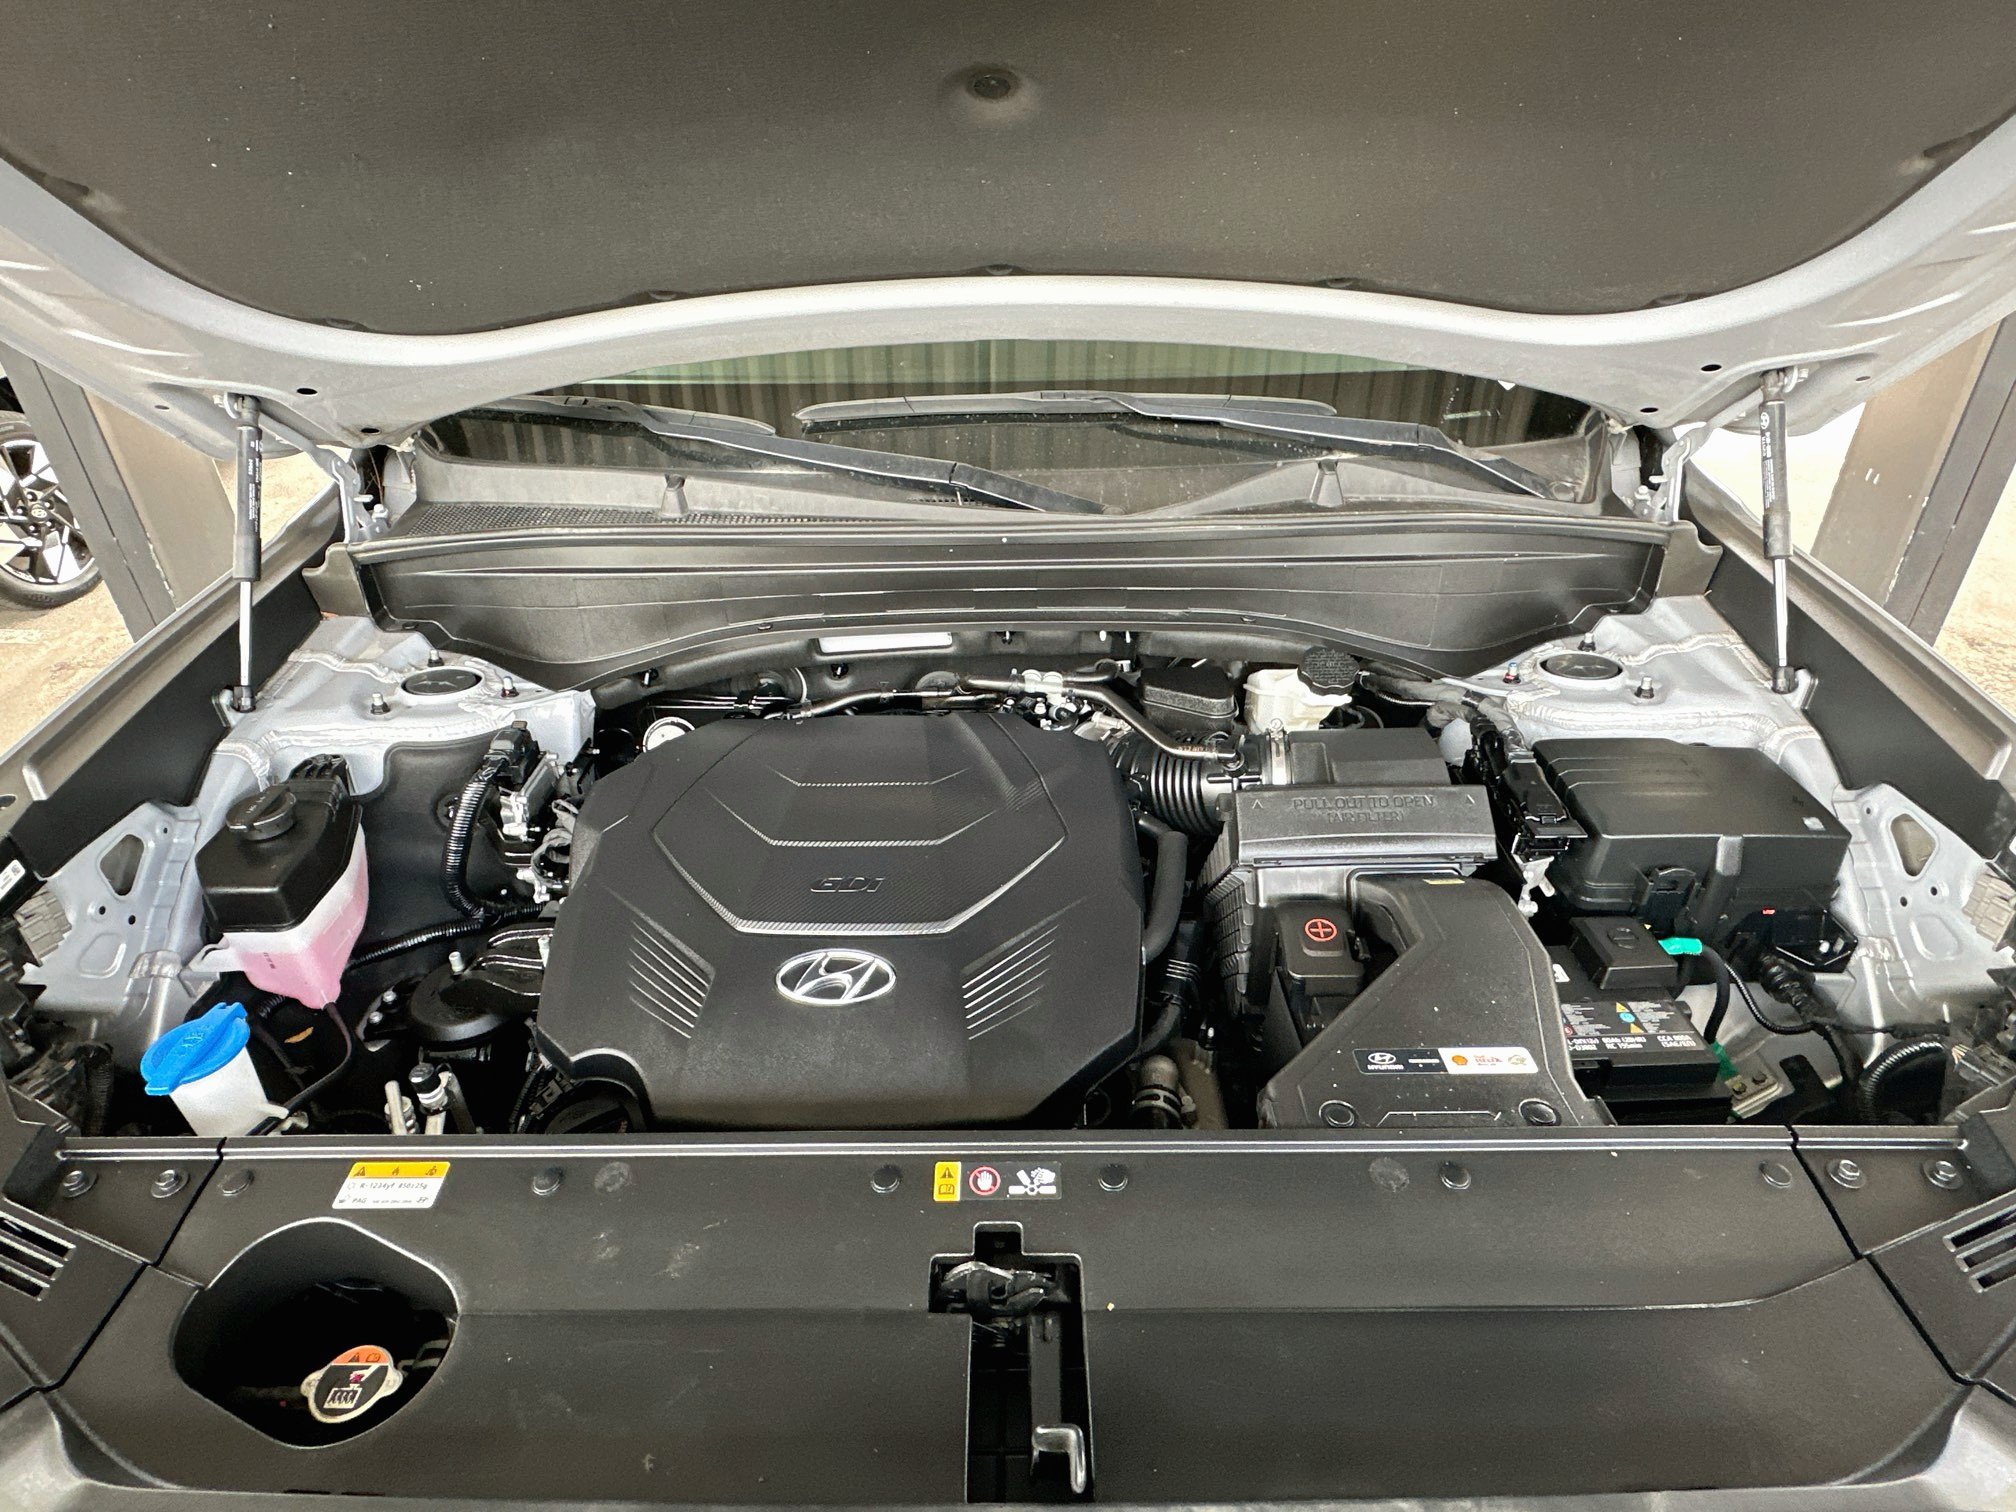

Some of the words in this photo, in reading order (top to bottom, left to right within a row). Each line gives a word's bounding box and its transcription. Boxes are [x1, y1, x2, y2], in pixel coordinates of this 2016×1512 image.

[1293, 797, 1333, 810] PULL
[1335, 796, 1364, 809] OUT
[1368, 795, 1389, 808] TO
[1393, 794, 1434, 808] OPEN
[360, 1182, 396, 1190] R-1234yf
